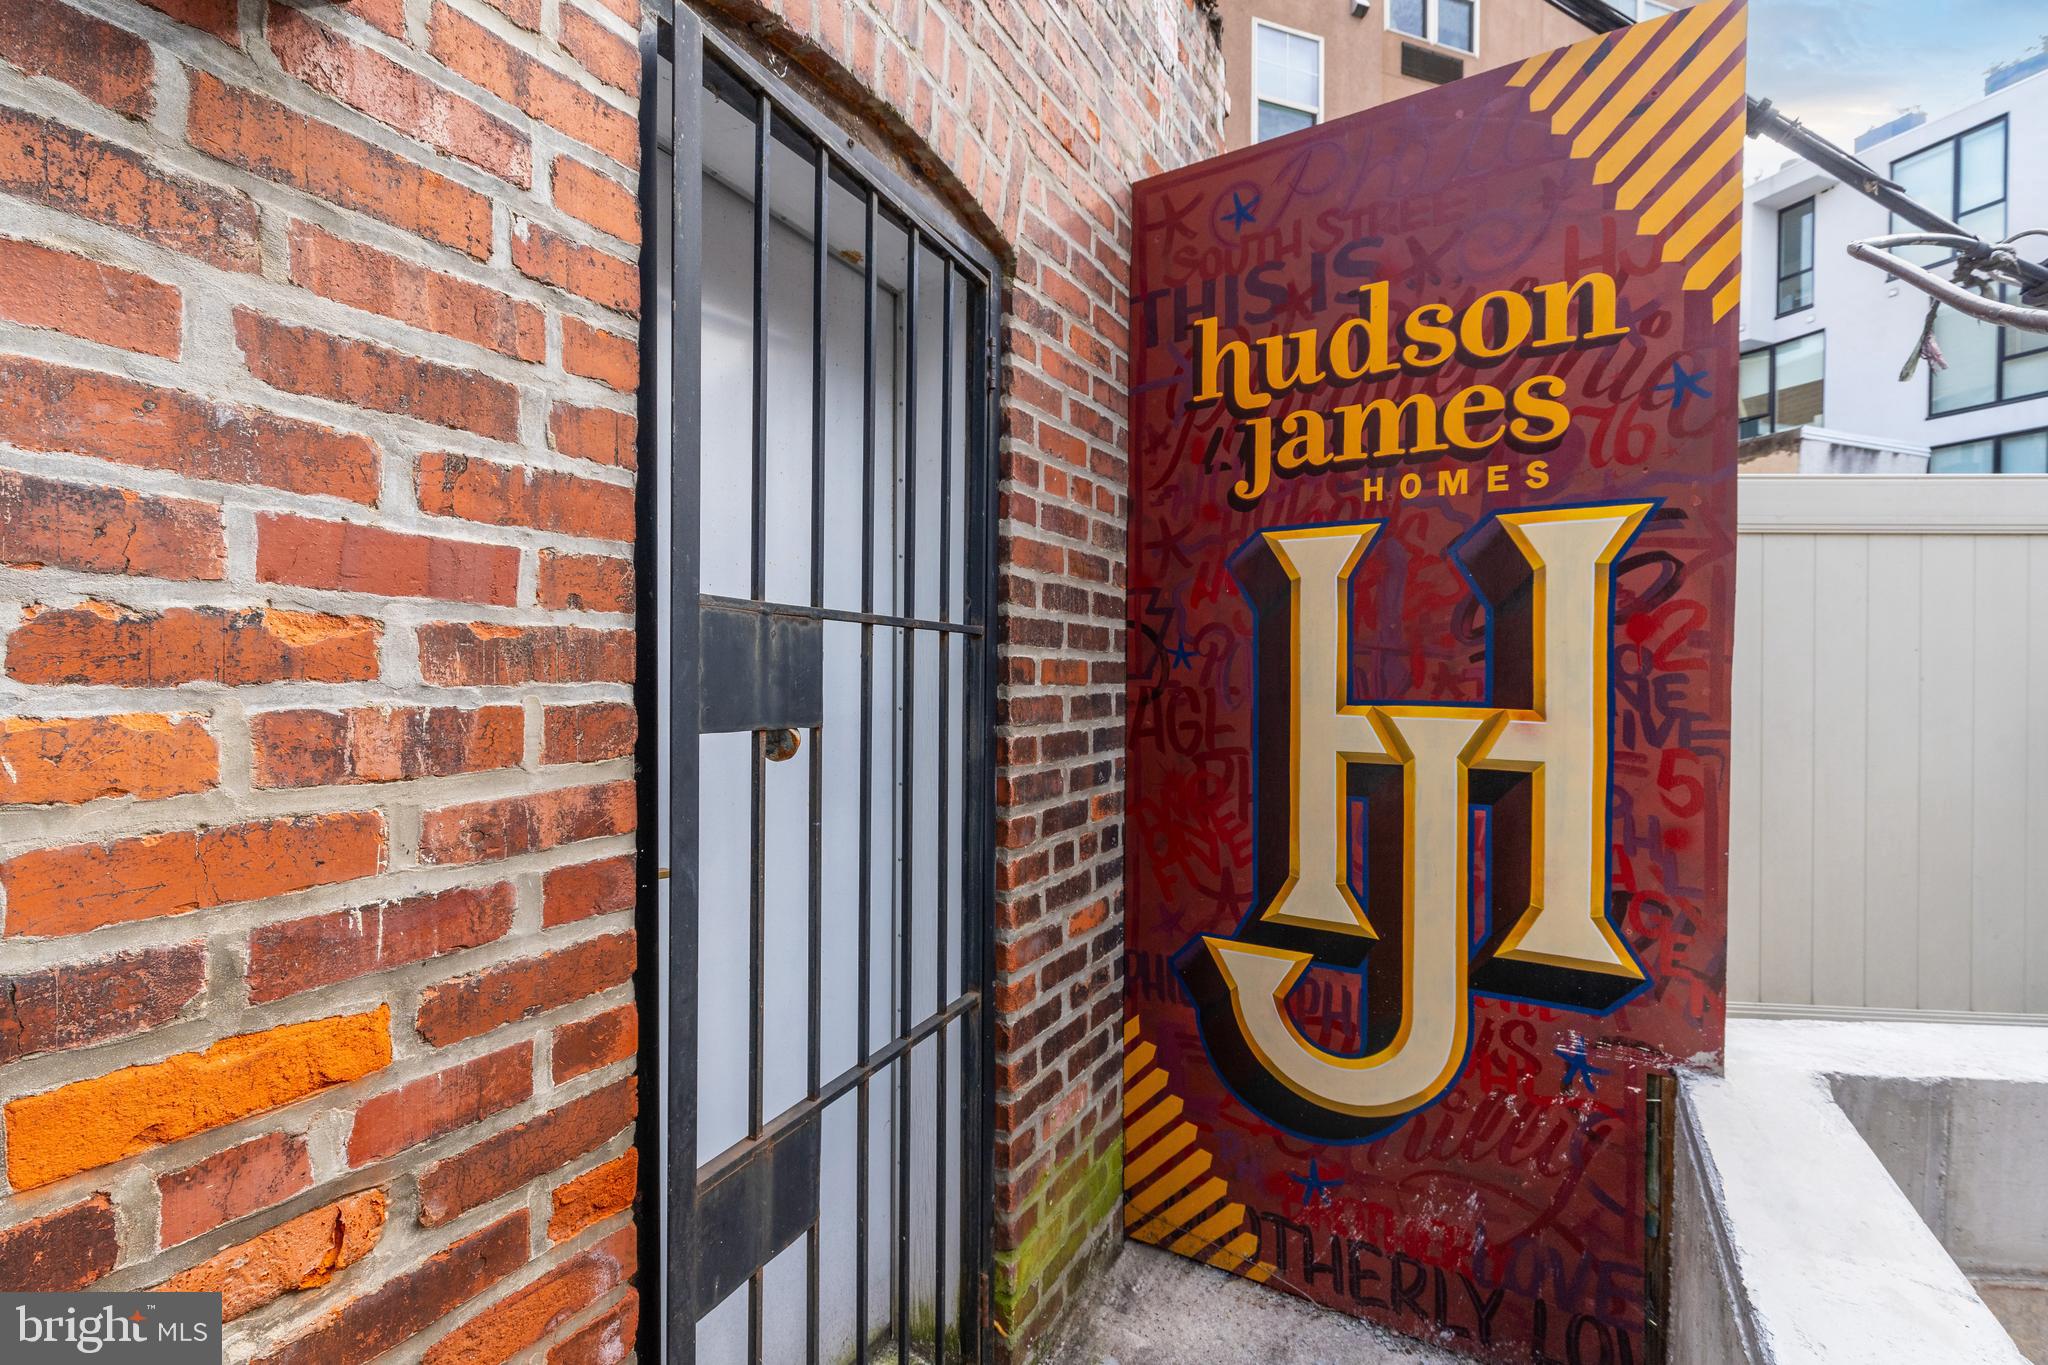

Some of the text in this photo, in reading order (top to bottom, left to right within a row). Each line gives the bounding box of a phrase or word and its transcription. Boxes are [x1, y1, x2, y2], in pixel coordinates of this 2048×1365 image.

[1163, 218, 1301, 288] SOUTH
[1193, 271, 1631, 410] hudson
[1233, 374, 1572, 500] james
[1363, 459, 1551, 503] HOMES
